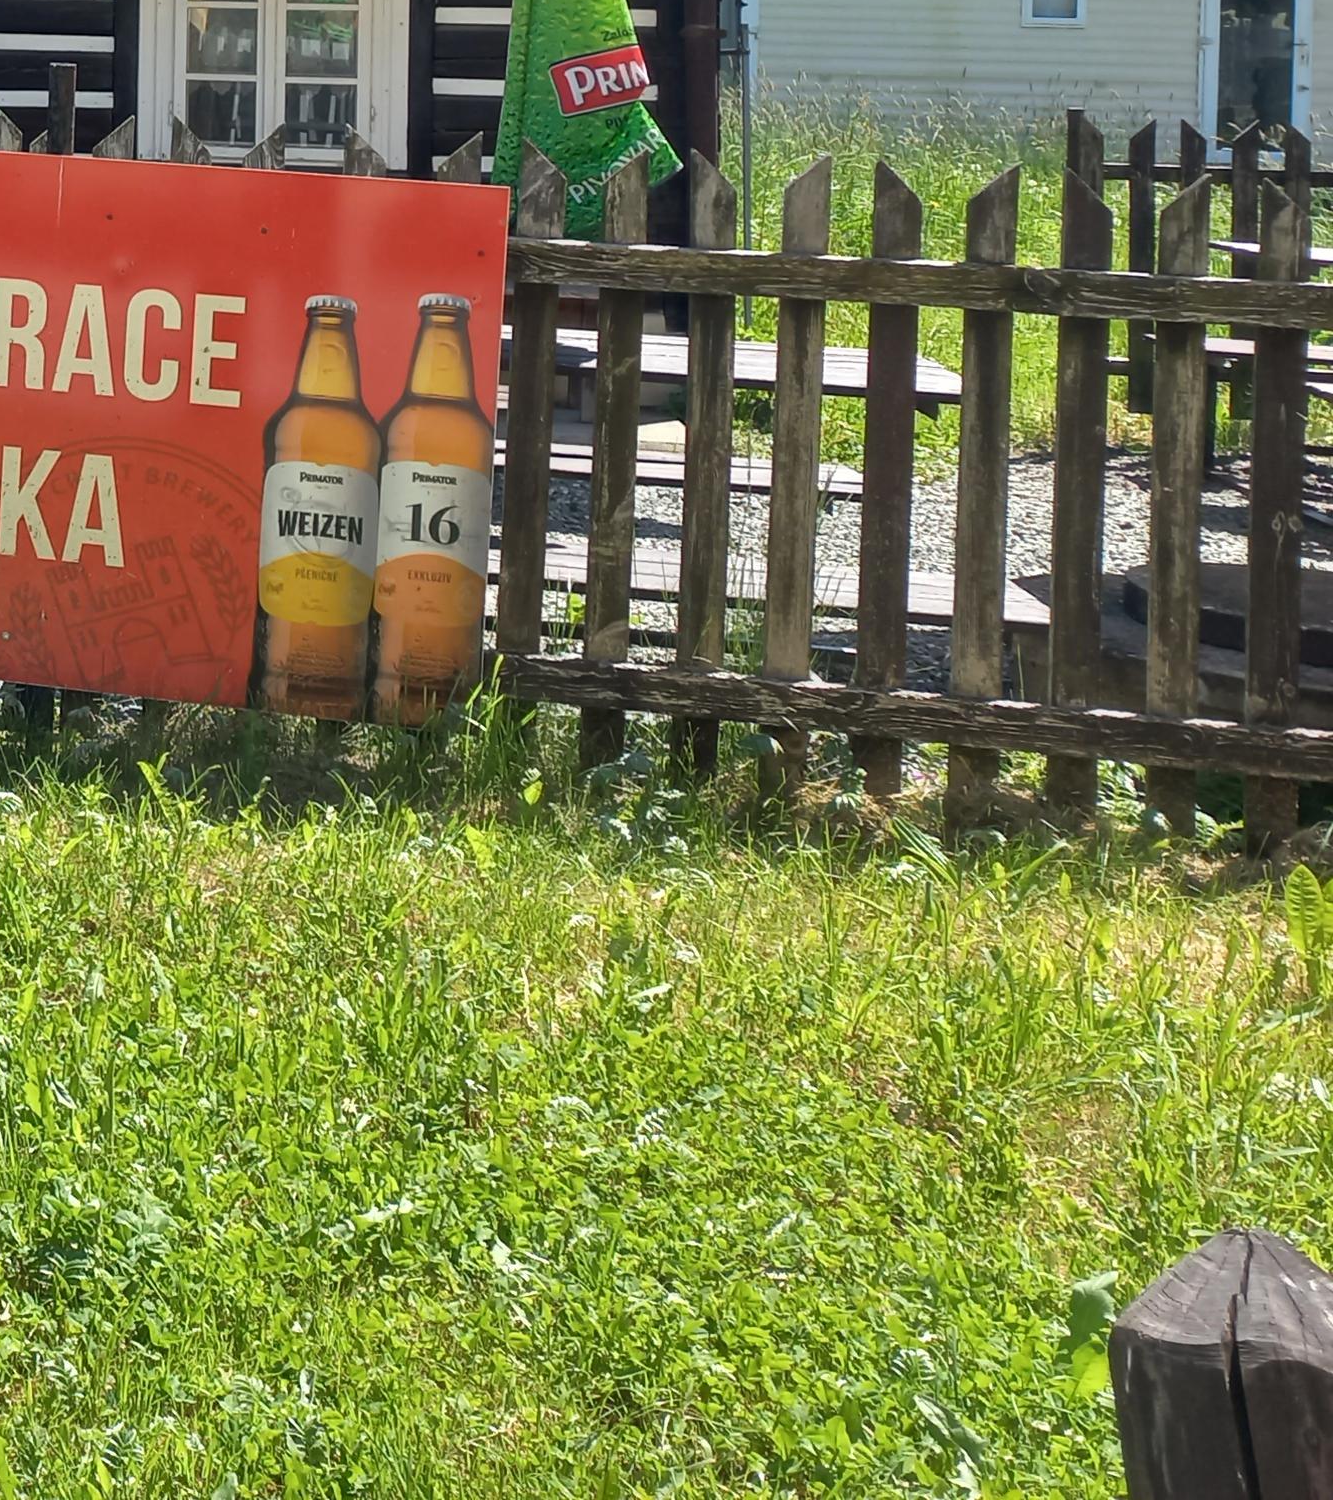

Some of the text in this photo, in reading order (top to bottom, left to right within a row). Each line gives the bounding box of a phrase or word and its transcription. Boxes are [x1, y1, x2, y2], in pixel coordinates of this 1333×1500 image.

[299, 471, 344, 486] PRIMATOR
[412, 471, 458, 486] PRIMATOR
[146, 465, 257, 541] BREWERY
[278, 509, 363, 546] WEIZEN
[402, 503, 461, 545] 16
[407, 569, 453, 584] EXKLUZIV
